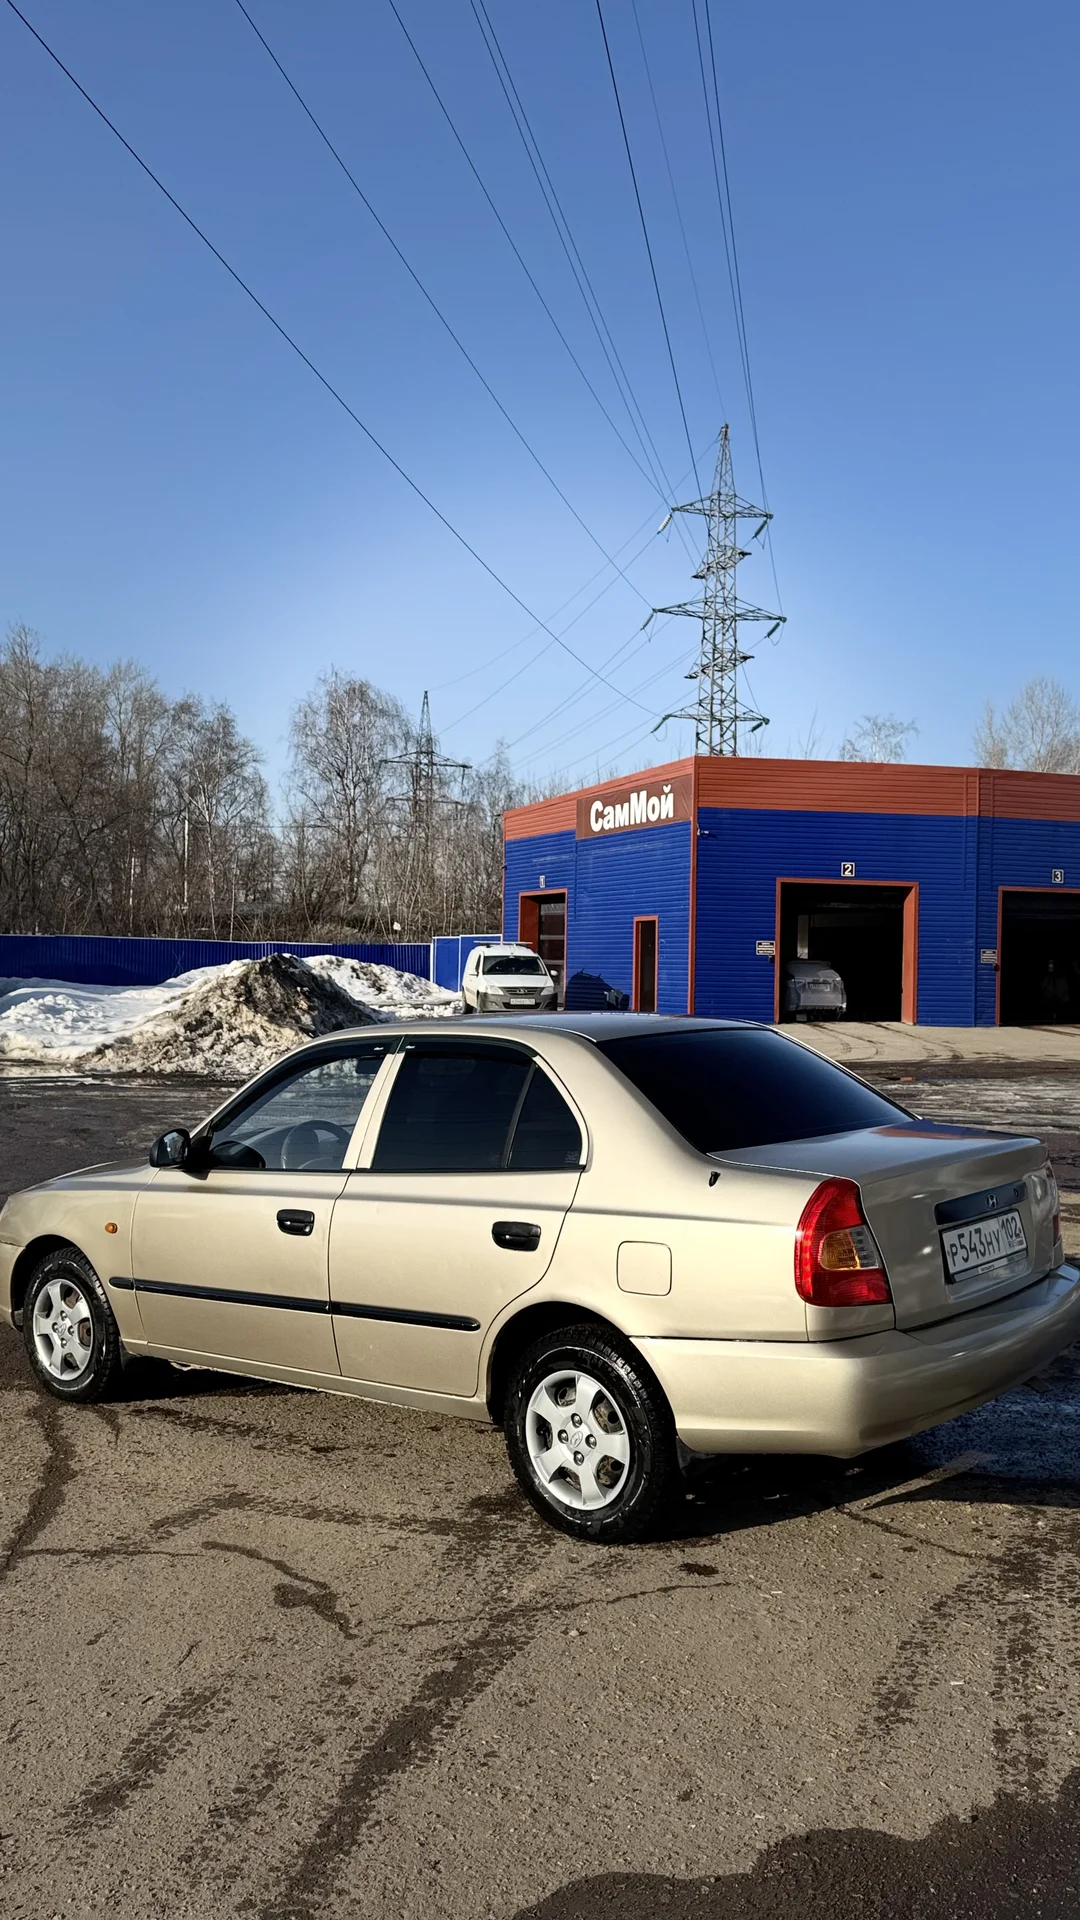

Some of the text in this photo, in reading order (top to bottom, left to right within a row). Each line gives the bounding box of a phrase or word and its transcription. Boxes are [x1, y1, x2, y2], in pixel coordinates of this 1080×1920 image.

[590, 784, 674, 832] СамМой
[844, 864, 852, 875] 2
[1054, 871, 1061, 882] 3
[1001, 1216, 1020, 1239] 102
